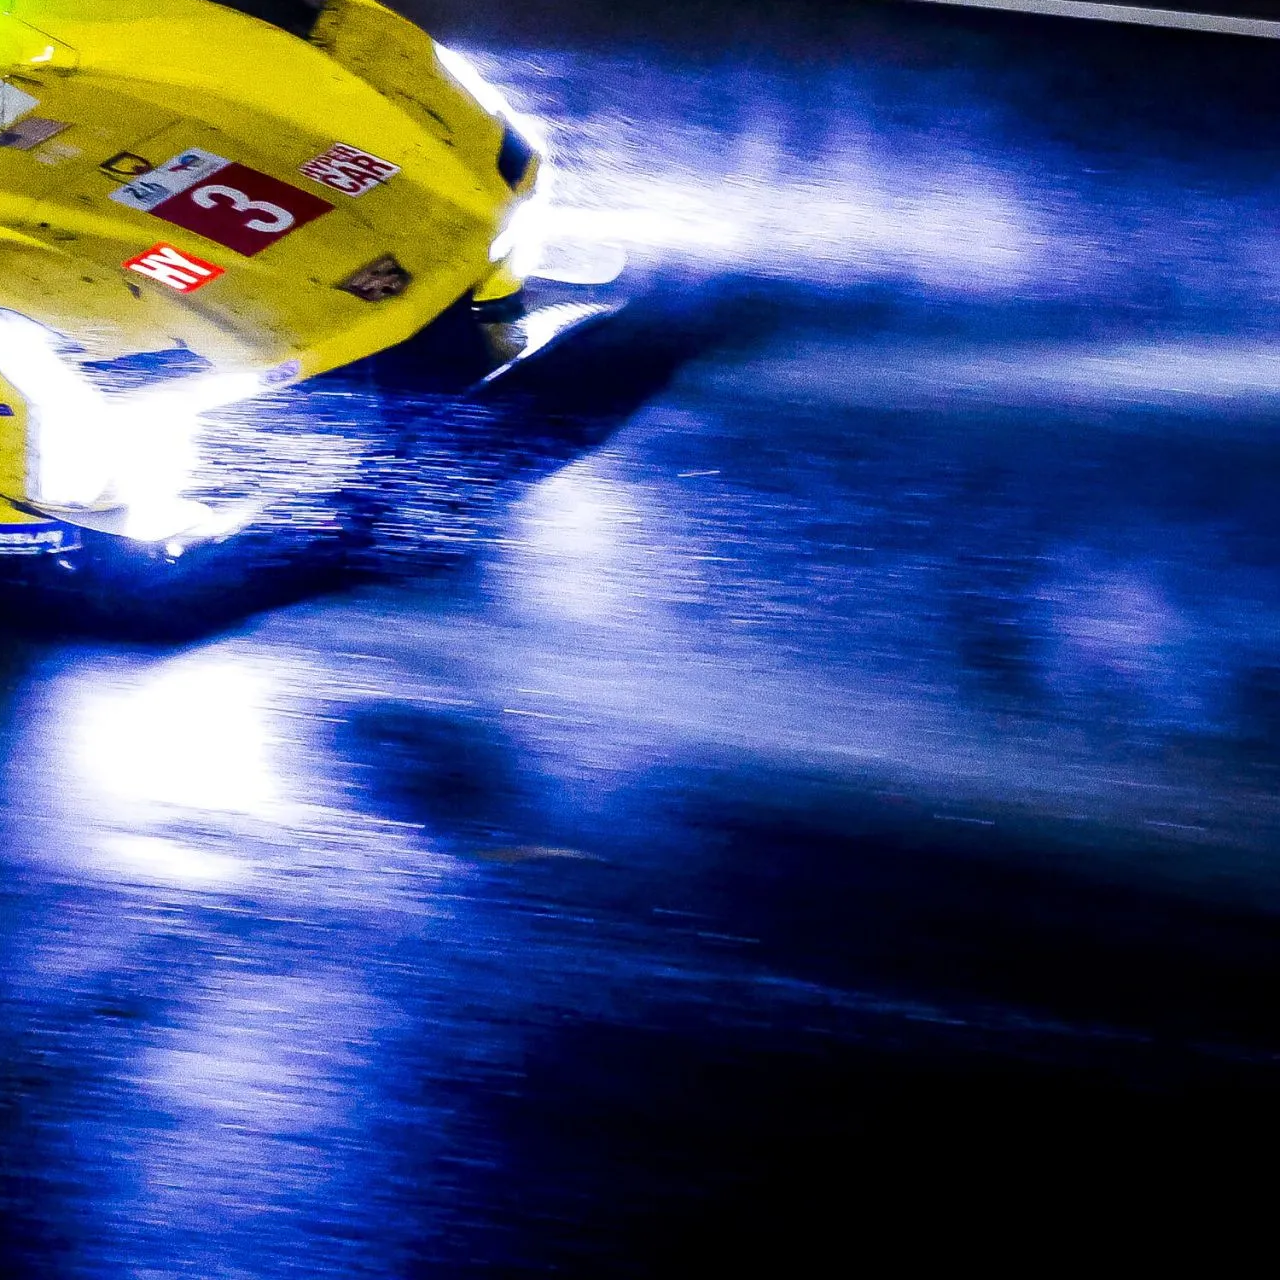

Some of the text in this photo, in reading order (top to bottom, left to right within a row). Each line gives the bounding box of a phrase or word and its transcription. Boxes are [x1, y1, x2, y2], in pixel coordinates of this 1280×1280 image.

[321, 155, 395, 193] CAR
[191, 183, 296, 234] 3
[129, 246, 213, 290] HY
